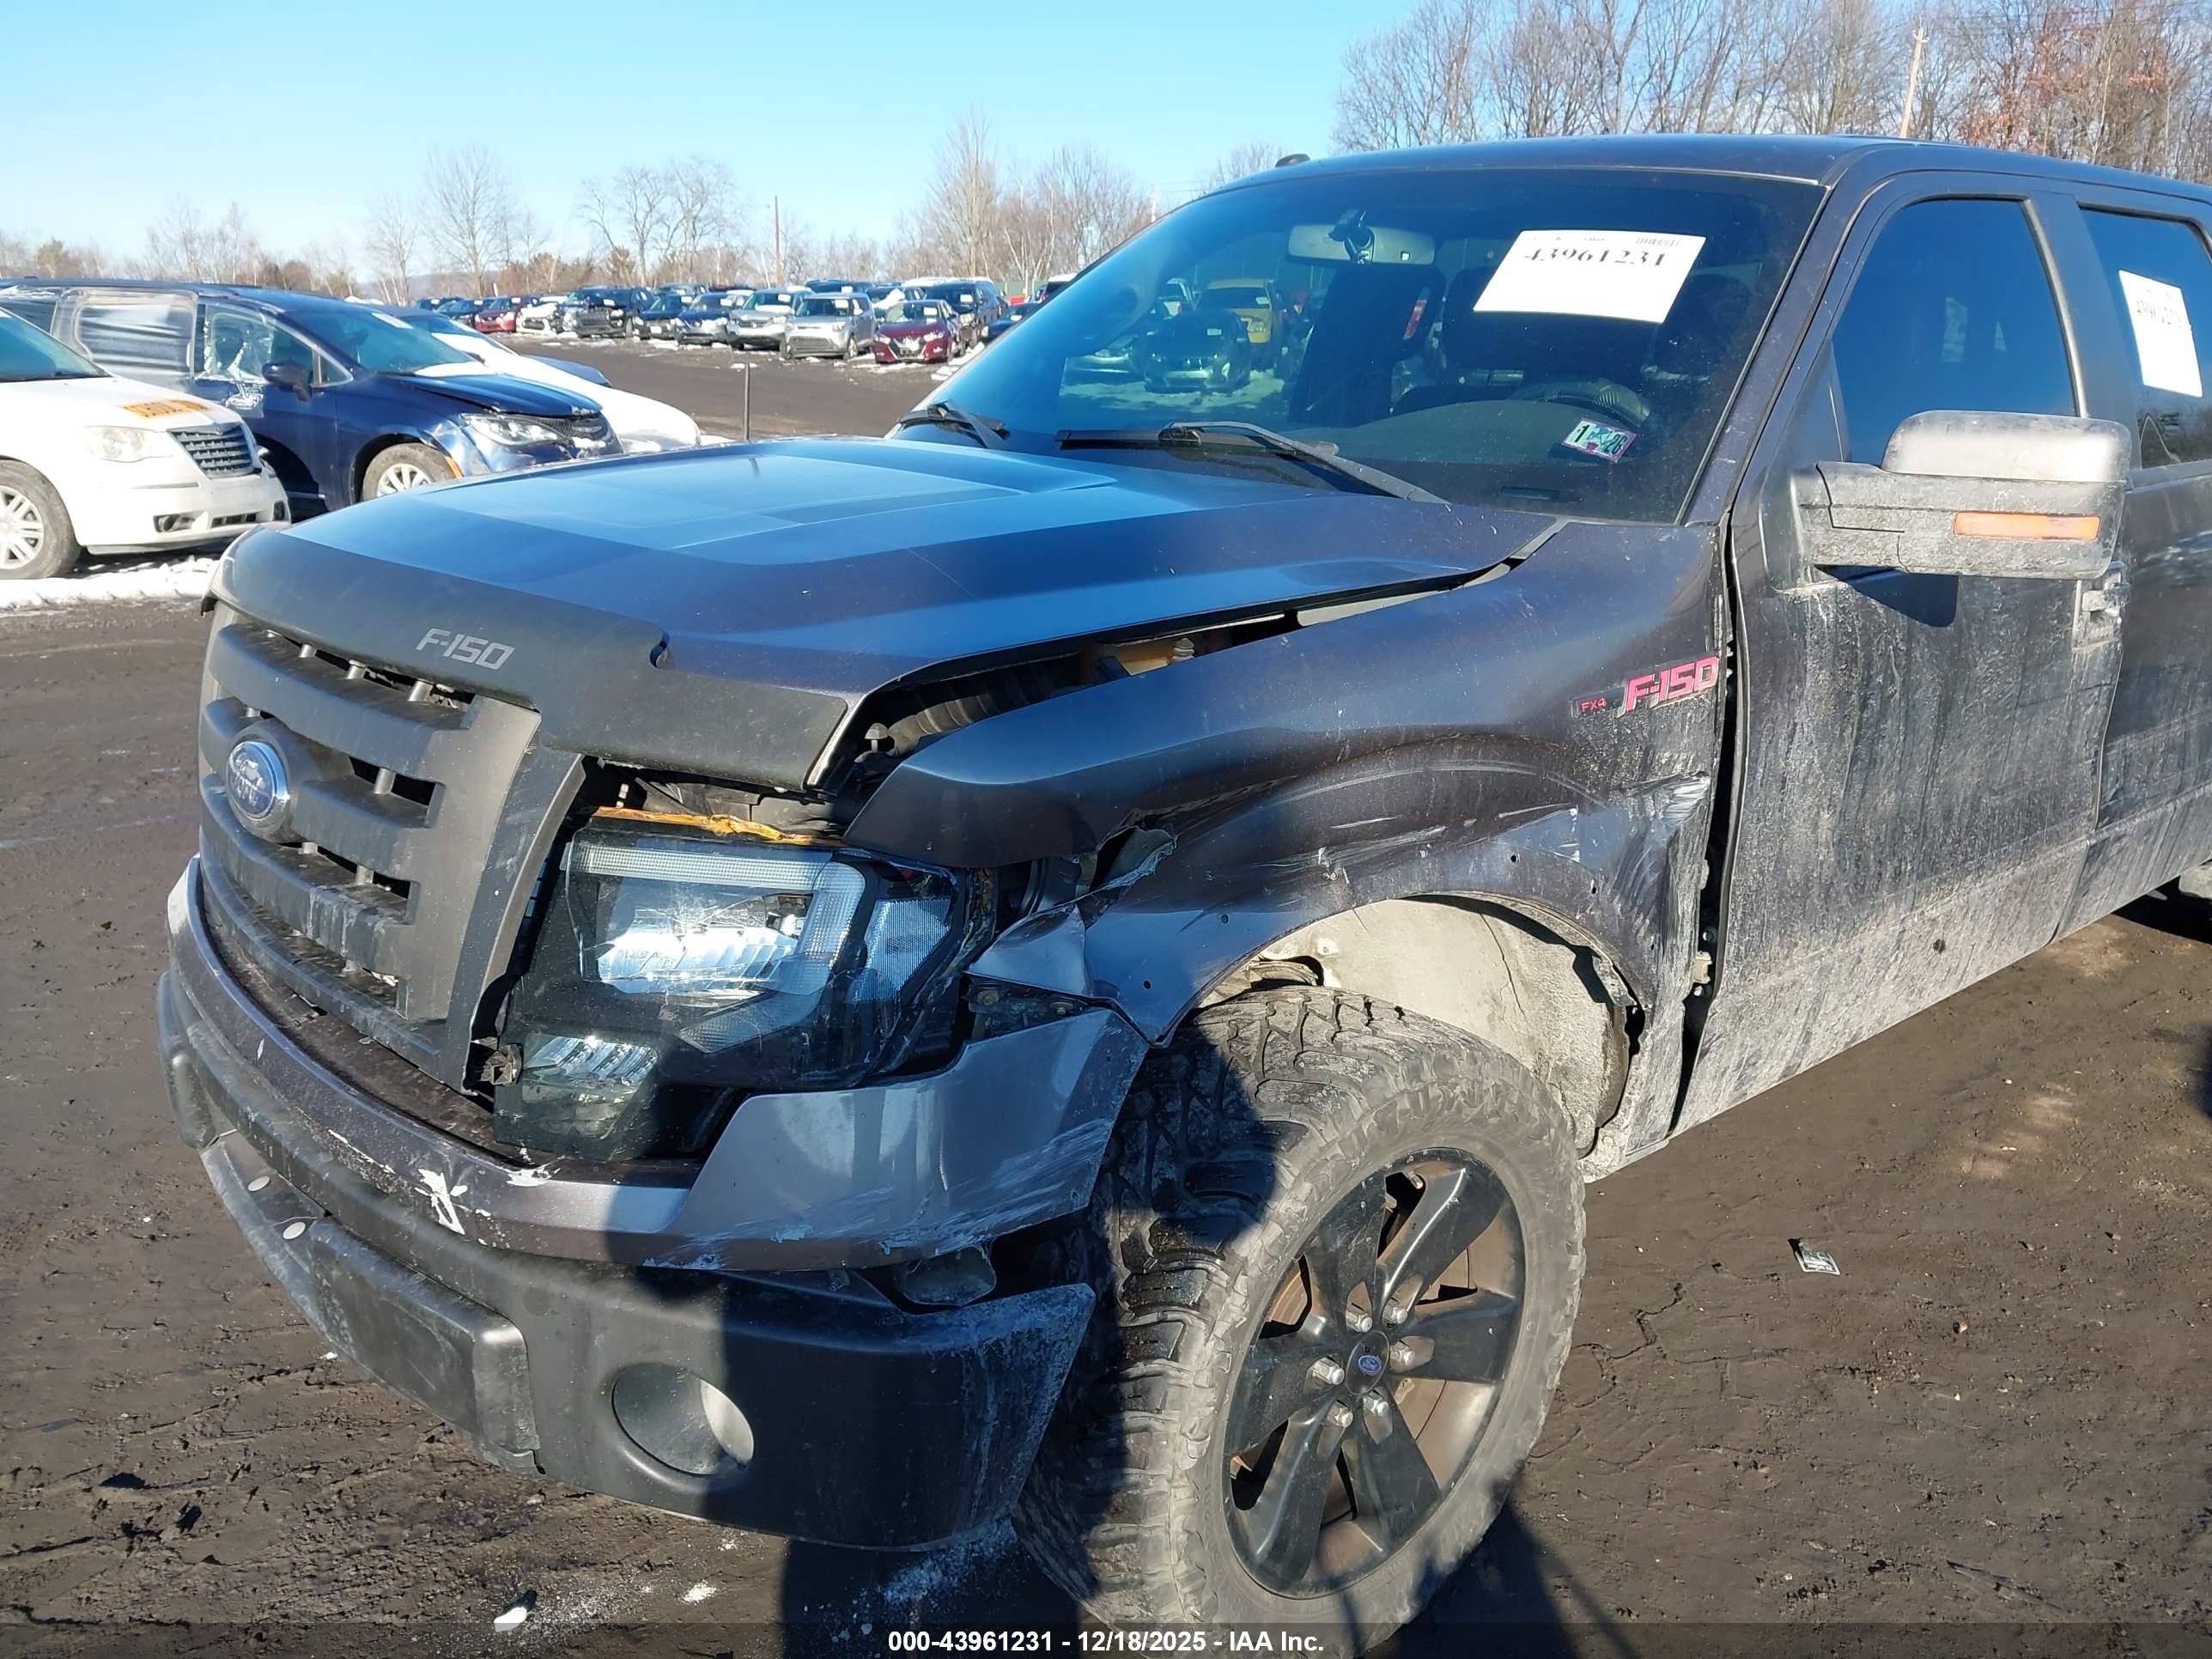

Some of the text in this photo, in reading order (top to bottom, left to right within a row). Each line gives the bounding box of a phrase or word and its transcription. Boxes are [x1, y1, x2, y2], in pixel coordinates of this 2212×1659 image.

[1573, 424, 1590, 443] 1
[415, 628, 515, 671] F-150
[1581, 655, 1720, 713] FX4 F-150
